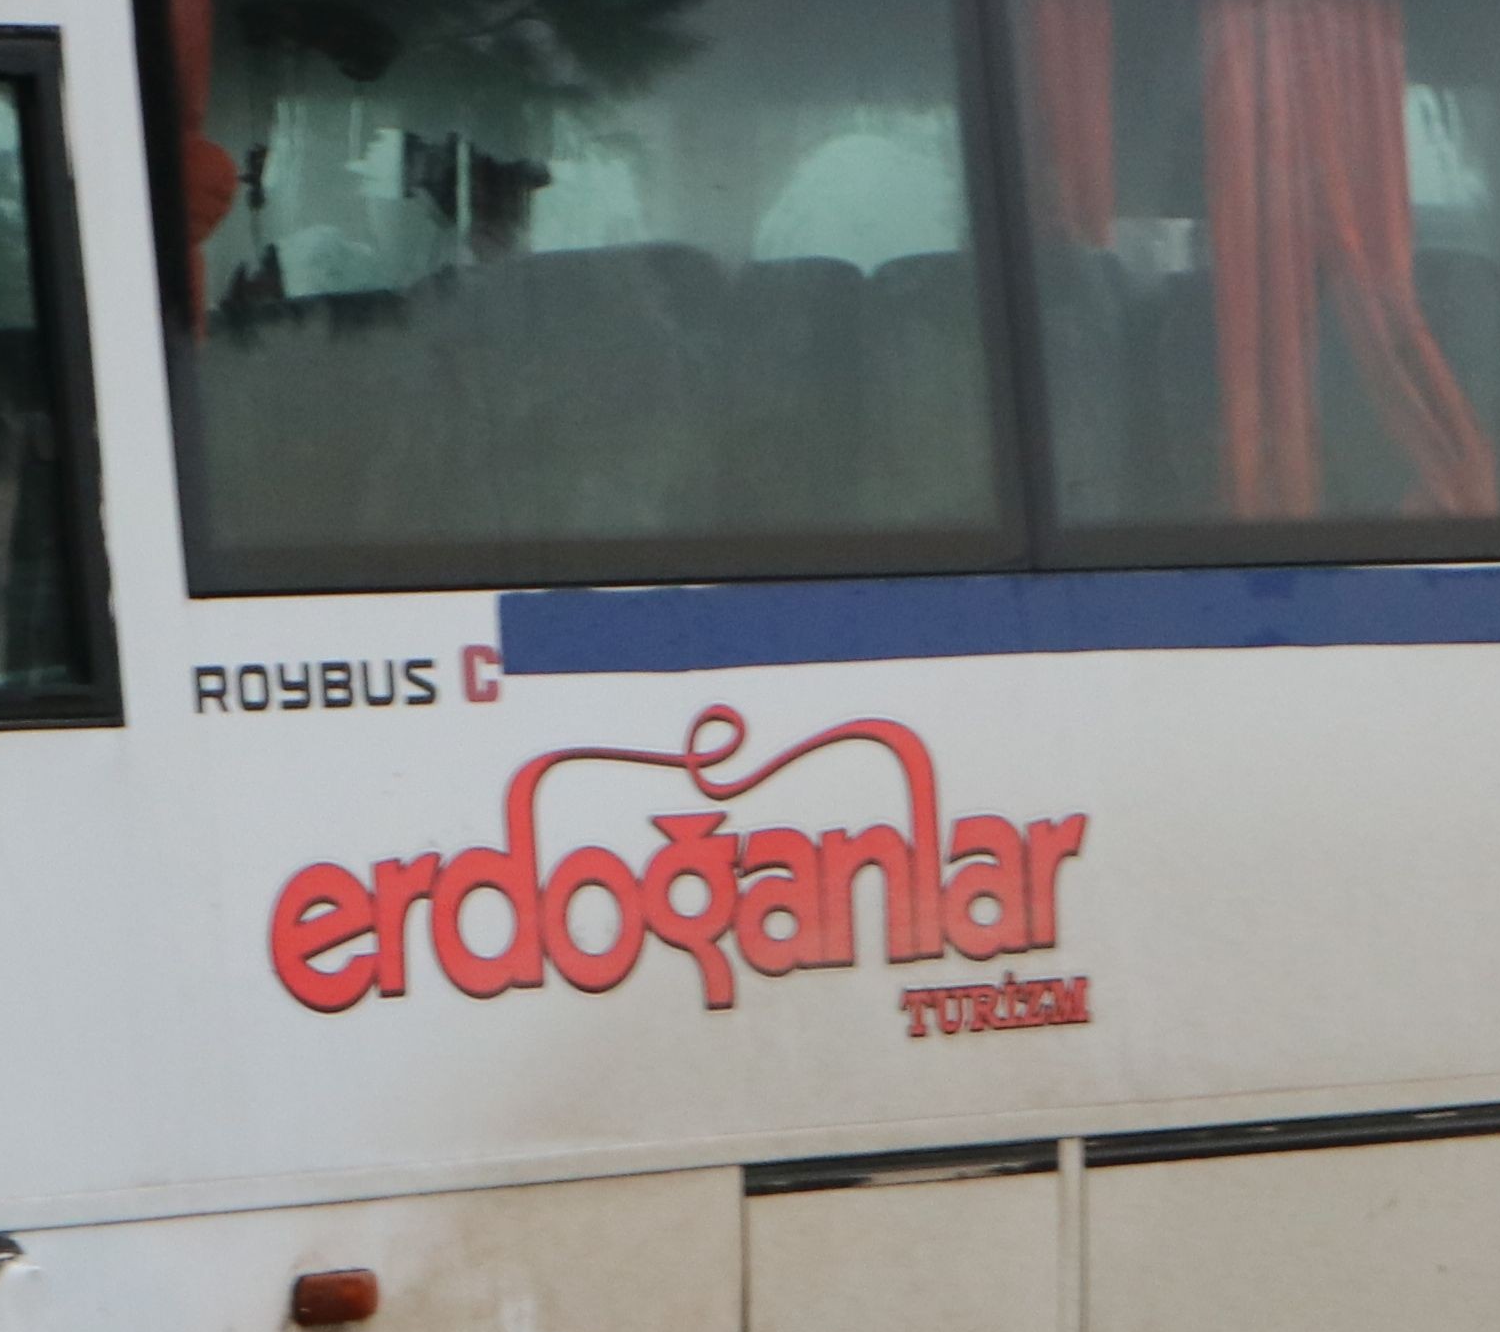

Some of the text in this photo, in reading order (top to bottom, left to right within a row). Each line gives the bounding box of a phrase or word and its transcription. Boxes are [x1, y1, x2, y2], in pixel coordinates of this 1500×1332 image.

[194, 643, 501, 715] ROYBUS C
[268, 702, 1088, 1014] erdoğanlar
[901, 970, 1092, 1037] TURİZM
